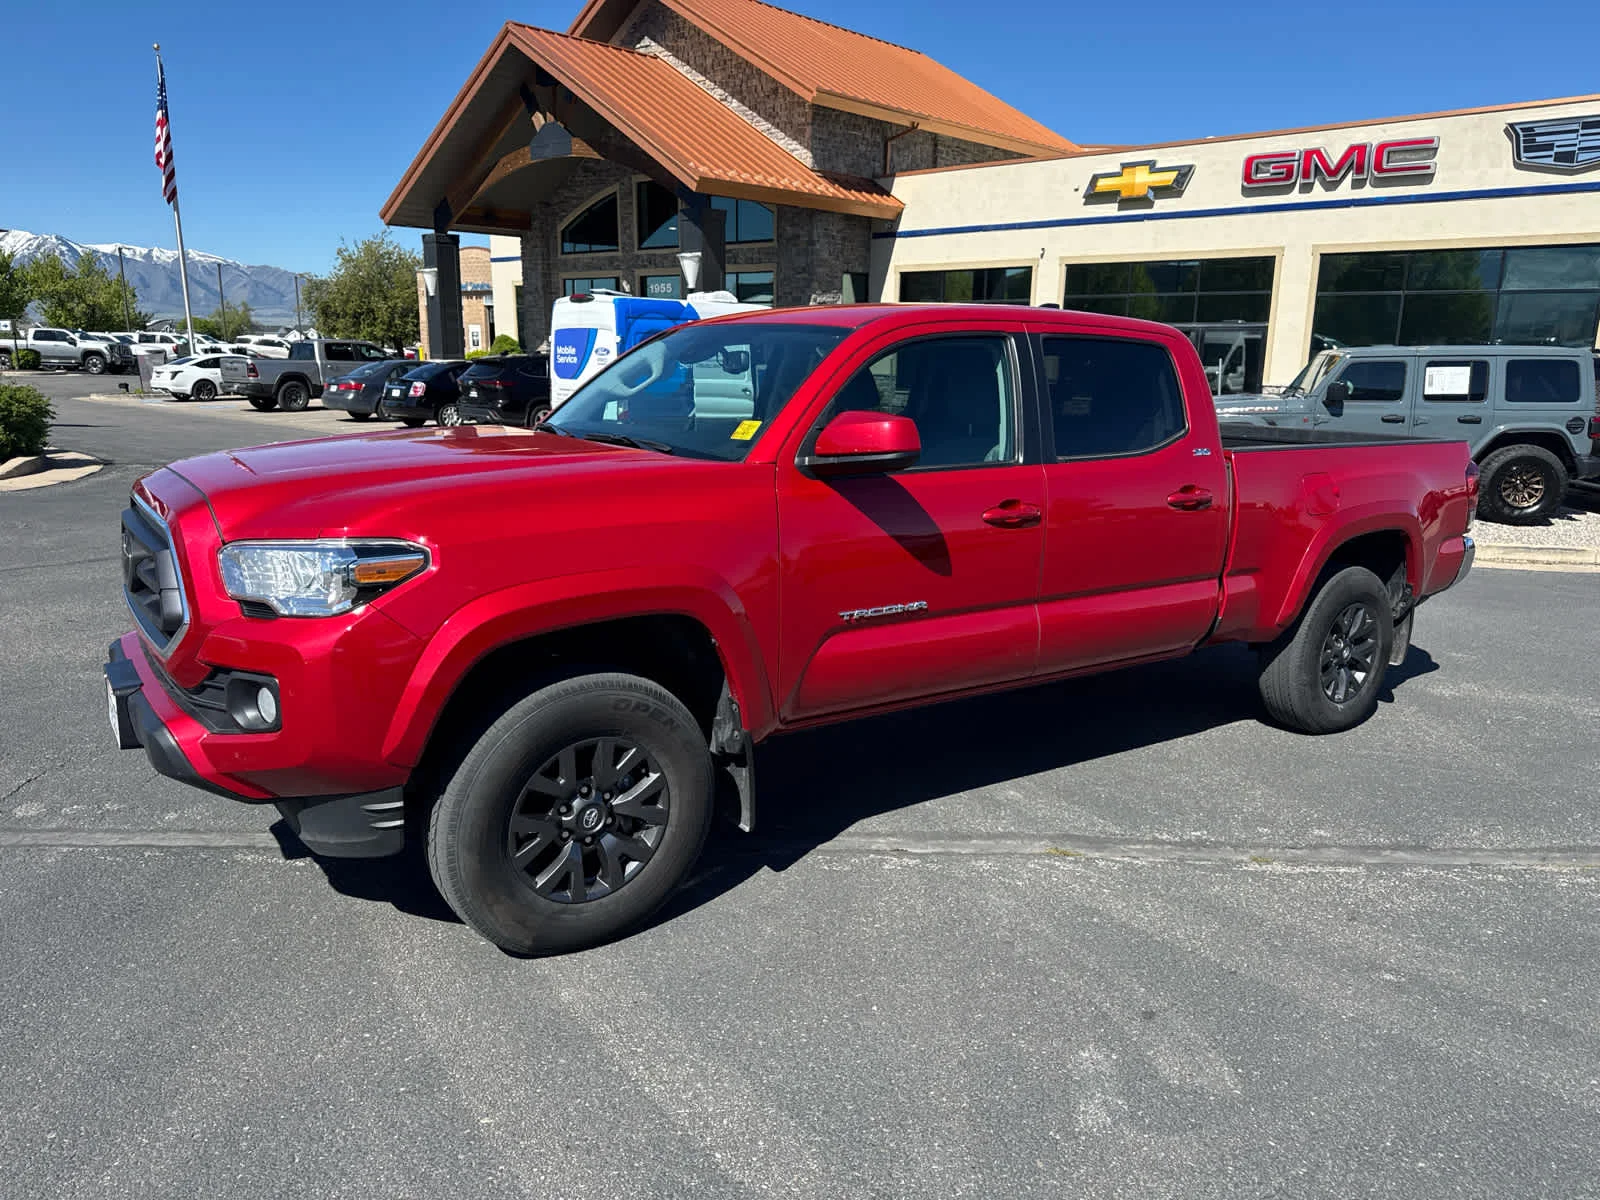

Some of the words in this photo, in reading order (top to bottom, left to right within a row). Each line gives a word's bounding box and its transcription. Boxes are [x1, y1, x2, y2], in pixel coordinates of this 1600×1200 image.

[1242, 136, 1440, 189] GMC
[649, 283, 673, 294] 1955
[556, 345, 576, 355] Mobile
[556, 354, 578, 364] Service
[839, 600, 928, 620] TACOMA
